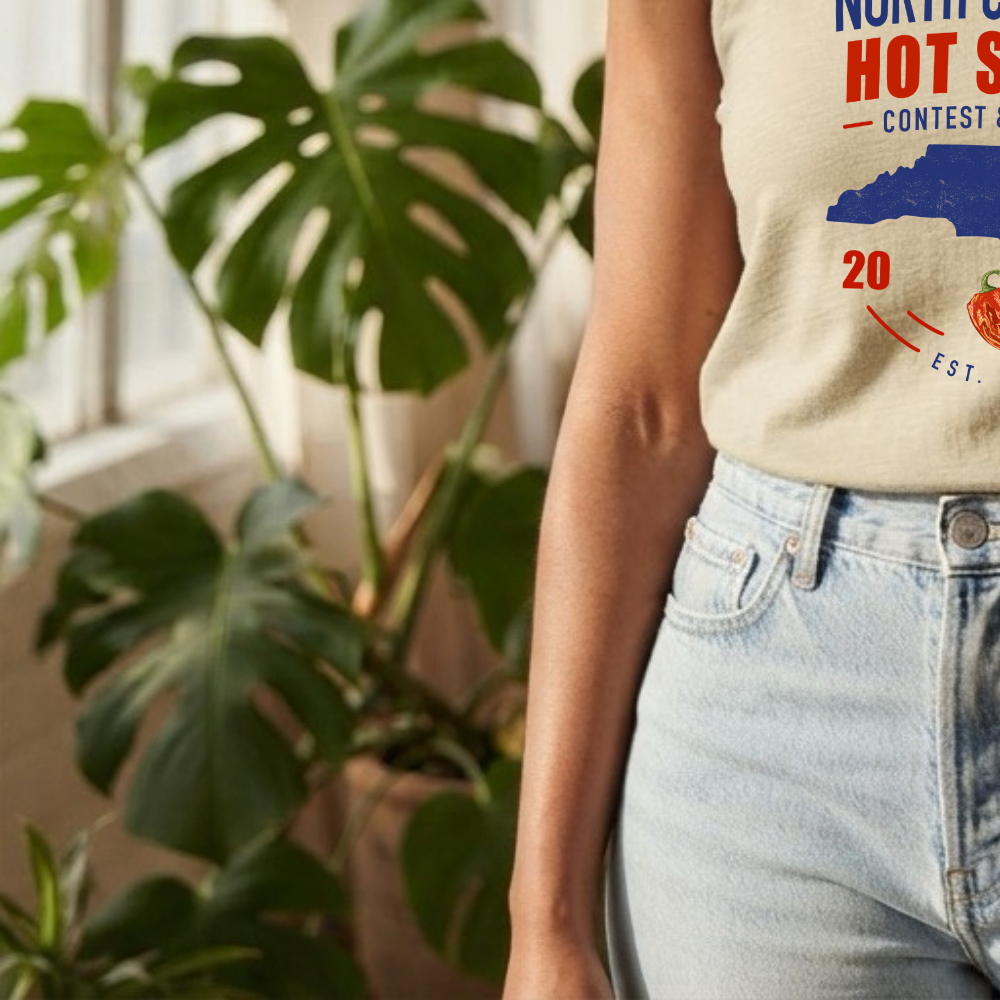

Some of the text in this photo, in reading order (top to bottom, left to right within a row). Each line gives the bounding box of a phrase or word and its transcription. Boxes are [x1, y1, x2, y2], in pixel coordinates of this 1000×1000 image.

[845, 31, 958, 104] HOT
[883, 105, 987, 134] CONTEST
[842, 249, 891, 291] 20
[930, 351, 982, 385] EST.
